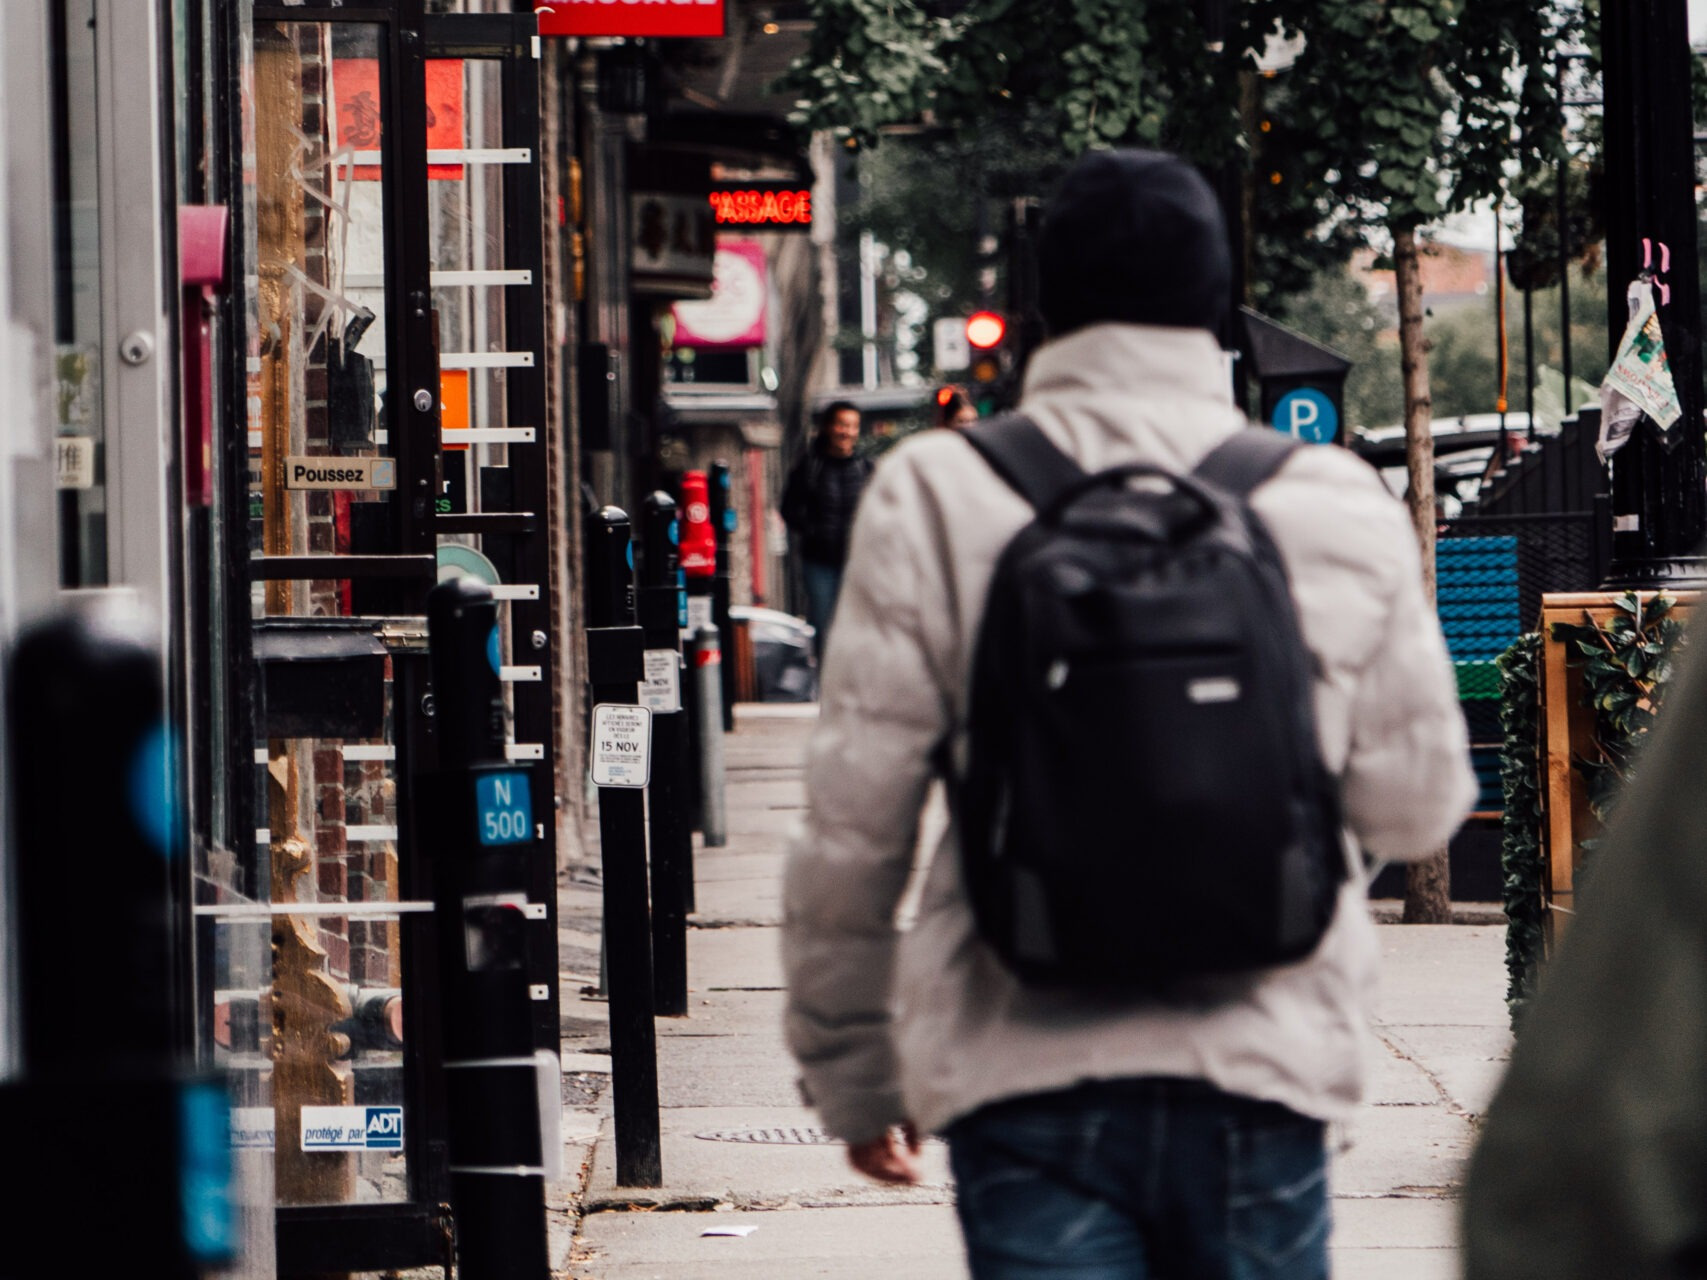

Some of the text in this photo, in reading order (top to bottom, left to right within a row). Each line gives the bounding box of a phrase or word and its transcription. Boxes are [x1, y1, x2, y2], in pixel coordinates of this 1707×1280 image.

[1290, 398, 1319, 440] P
[294, 465, 364, 482] Poussez
[601, 741, 613, 752] 15
[494, 779, 511, 806] N
[486, 810, 525, 839] 500
[305, 1112, 401, 1142] protégé par ADT
